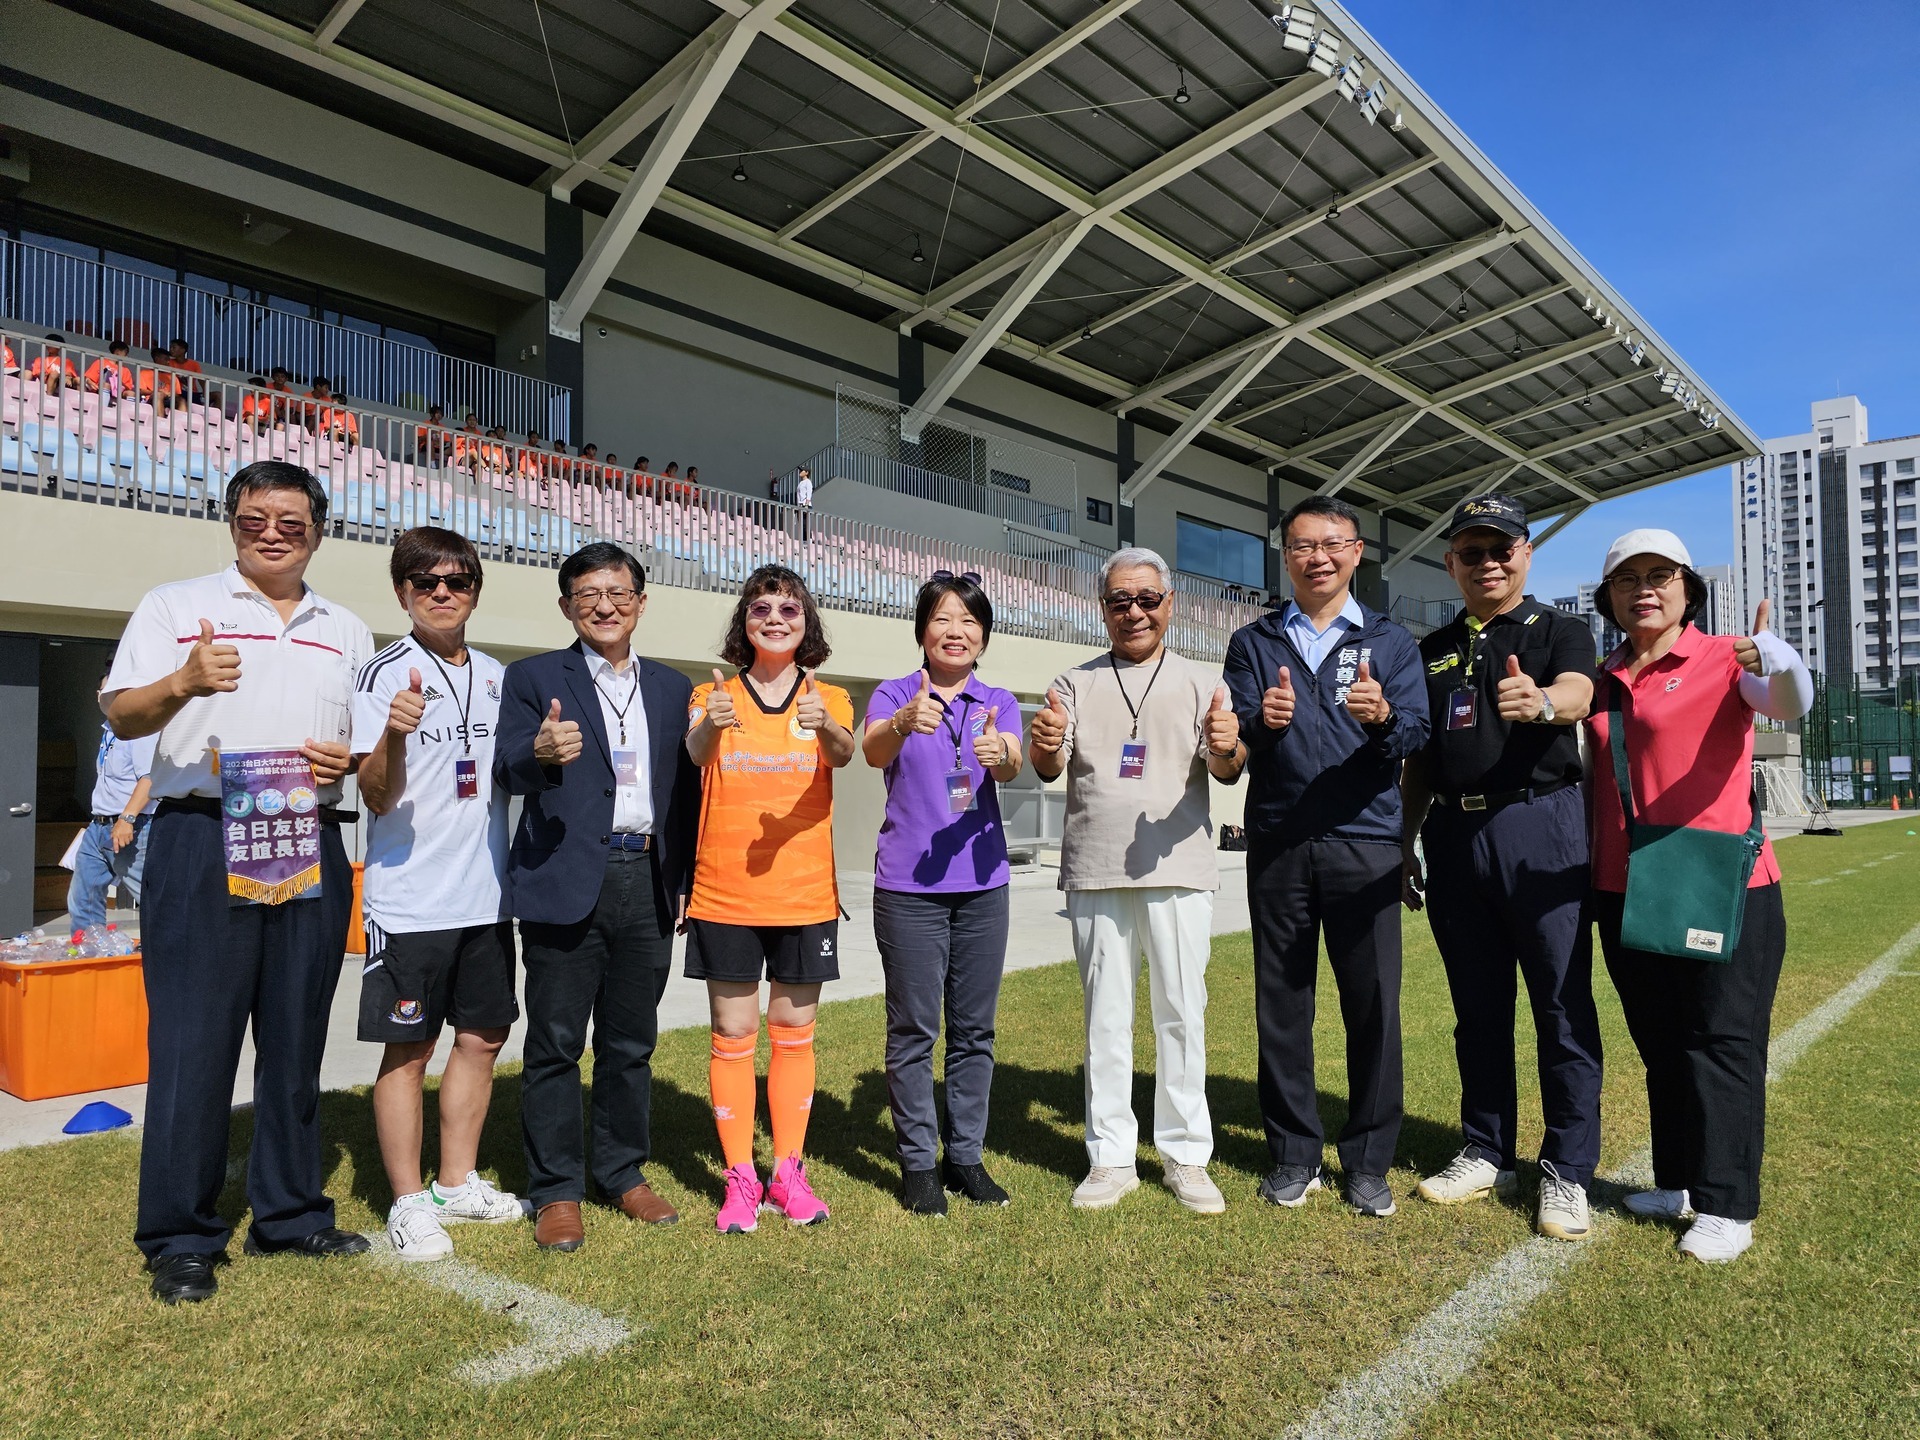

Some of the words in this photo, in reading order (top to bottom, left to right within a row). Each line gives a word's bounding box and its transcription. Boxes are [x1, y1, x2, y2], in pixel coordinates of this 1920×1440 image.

[721, 763, 738, 772] CPC
[227, 817, 316, 842] 台日友好
[228, 838, 318, 863] 友誼長存
